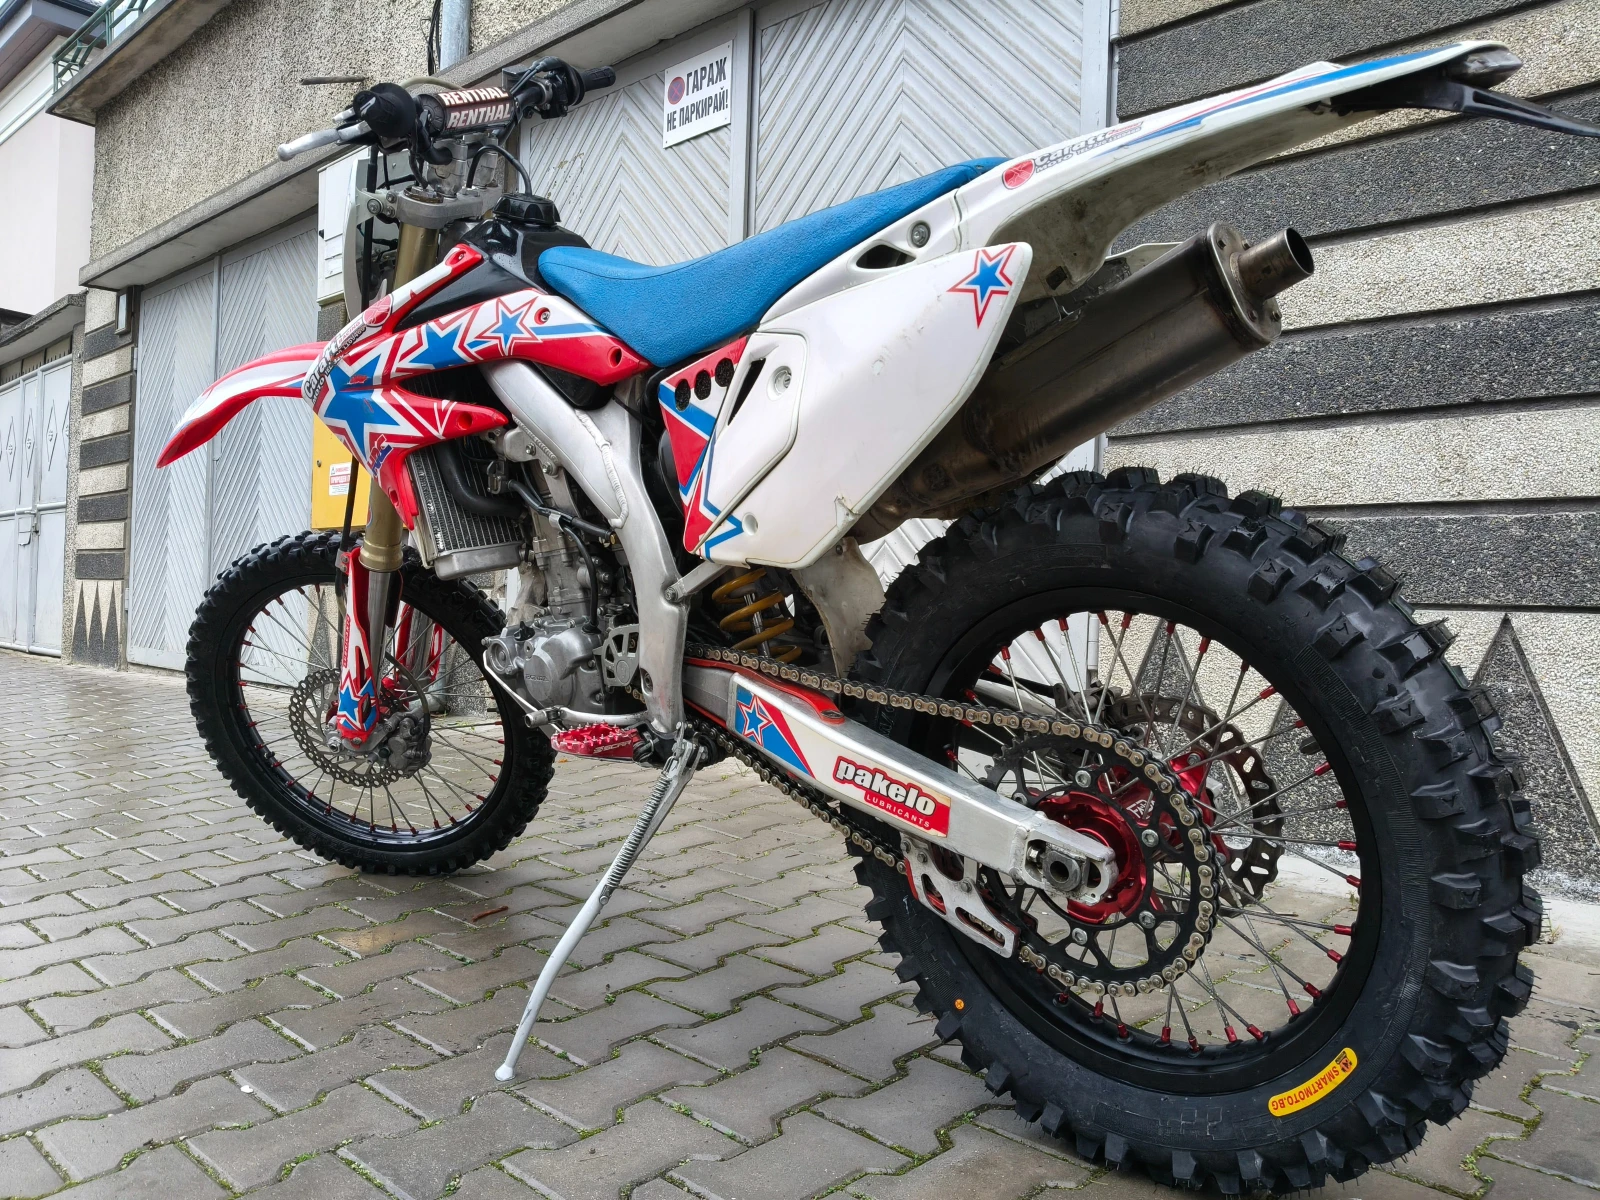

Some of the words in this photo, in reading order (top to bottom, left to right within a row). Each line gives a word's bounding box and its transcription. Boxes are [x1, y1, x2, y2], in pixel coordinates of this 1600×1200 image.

[438, 86, 509, 106] RENTHAL
[686, 56, 727, 96] ГАРАЖ
[447, 103, 511, 128] RENTHAL
[667, 110, 677, 132] НЕ
[679, 86, 729, 127] ПАРКИРАЙ!
[836, 760, 937, 816] pakelo
[866, 794, 931, 828] LUBRICANTS
[1271, 1066, 1340, 1110] SMARTMOTO.BG
